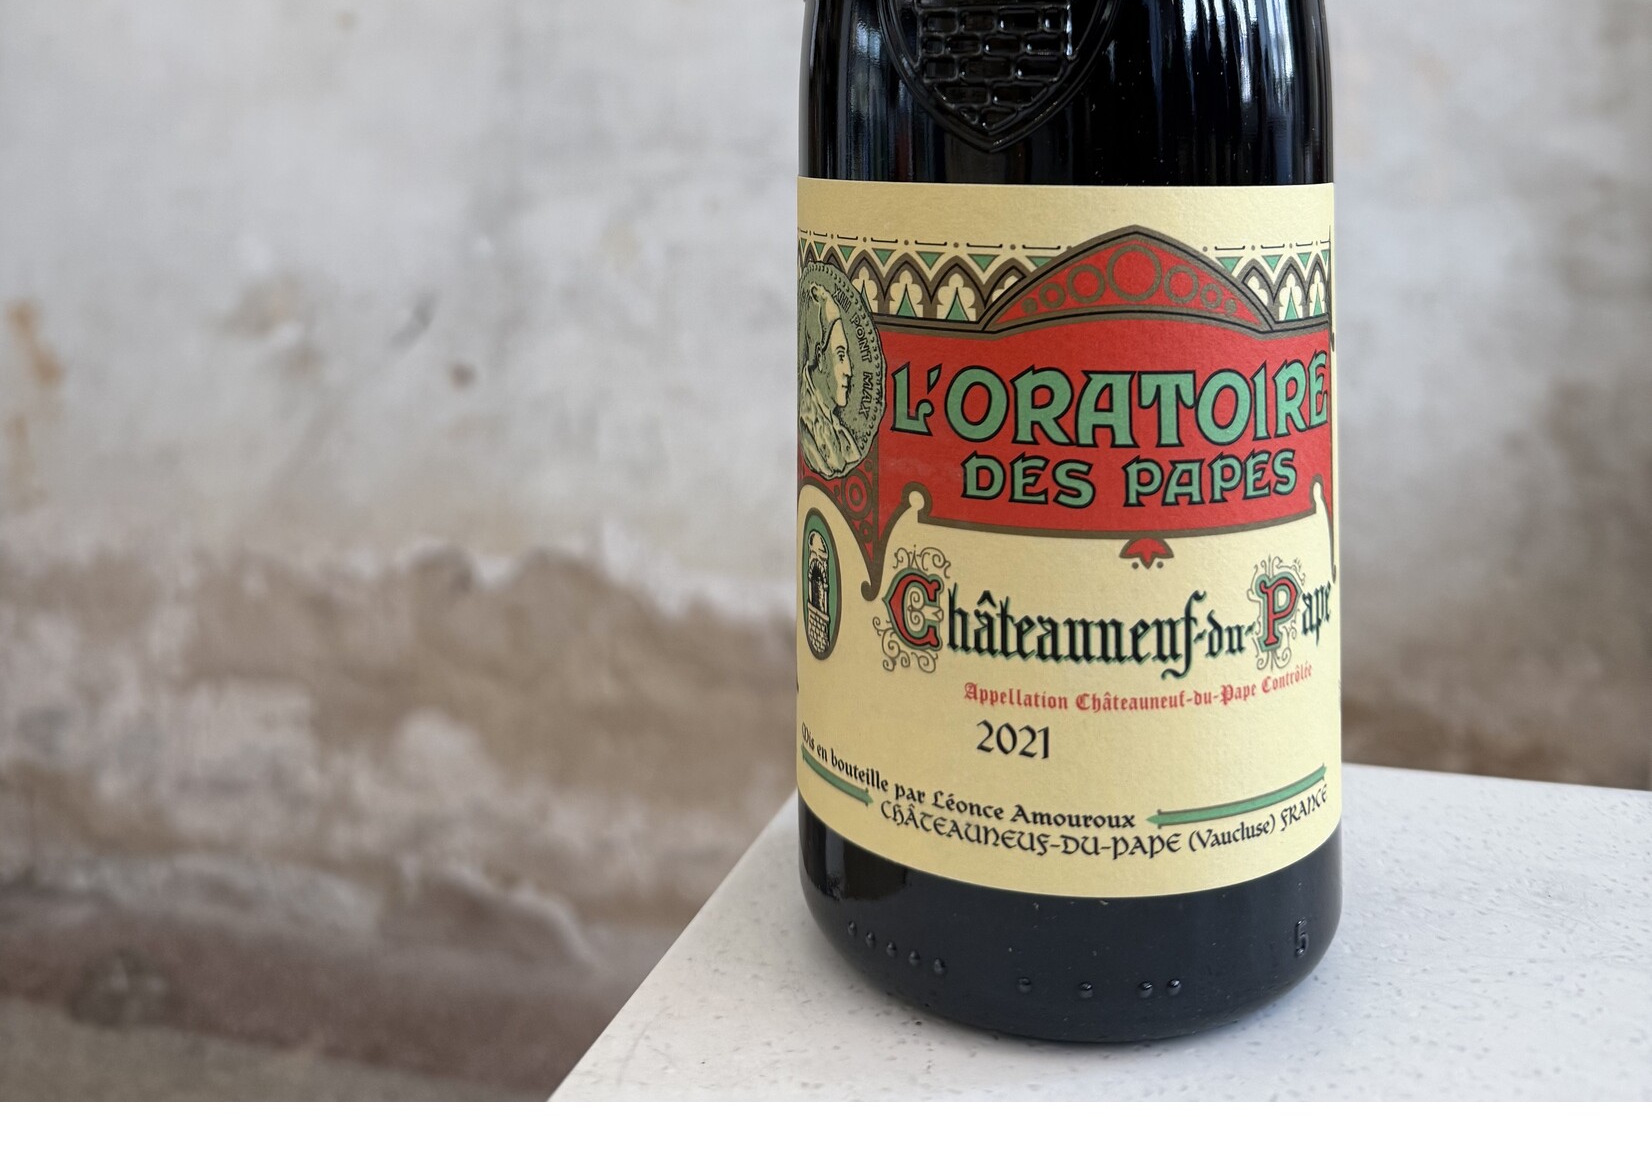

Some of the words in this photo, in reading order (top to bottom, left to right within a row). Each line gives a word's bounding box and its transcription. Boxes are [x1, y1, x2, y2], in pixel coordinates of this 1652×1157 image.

[851, 311, 873, 364] PONT
[858, 371, 874, 420] MAX
[889, 348, 1332, 449] L'ORATOIRE
[960, 450, 1096, 510] DES
[1123, 448, 1298, 509] PAPES
[876, 562, 1332, 680] Châteauneuf-du-Pape
[963, 681, 1069, 710] Appellation
[1075, 683, 1257, 713] Châteauneuf-du-Pape
[1261, 661, 1313, 694] Contrôlée
[976, 718, 1052, 761] 2021
[801, 721, 816, 751] Mis
[816, 744, 828, 763] en
[830, 747, 889, 793] bouteille
[894, 782, 926, 805] par
[932, 790, 1005, 821] Léonce
[1009, 803, 1136, 829] Amouroux
[1188, 812, 1277, 853] (Vaucluse)
[1280, 782, 1328, 833] FRANCE
